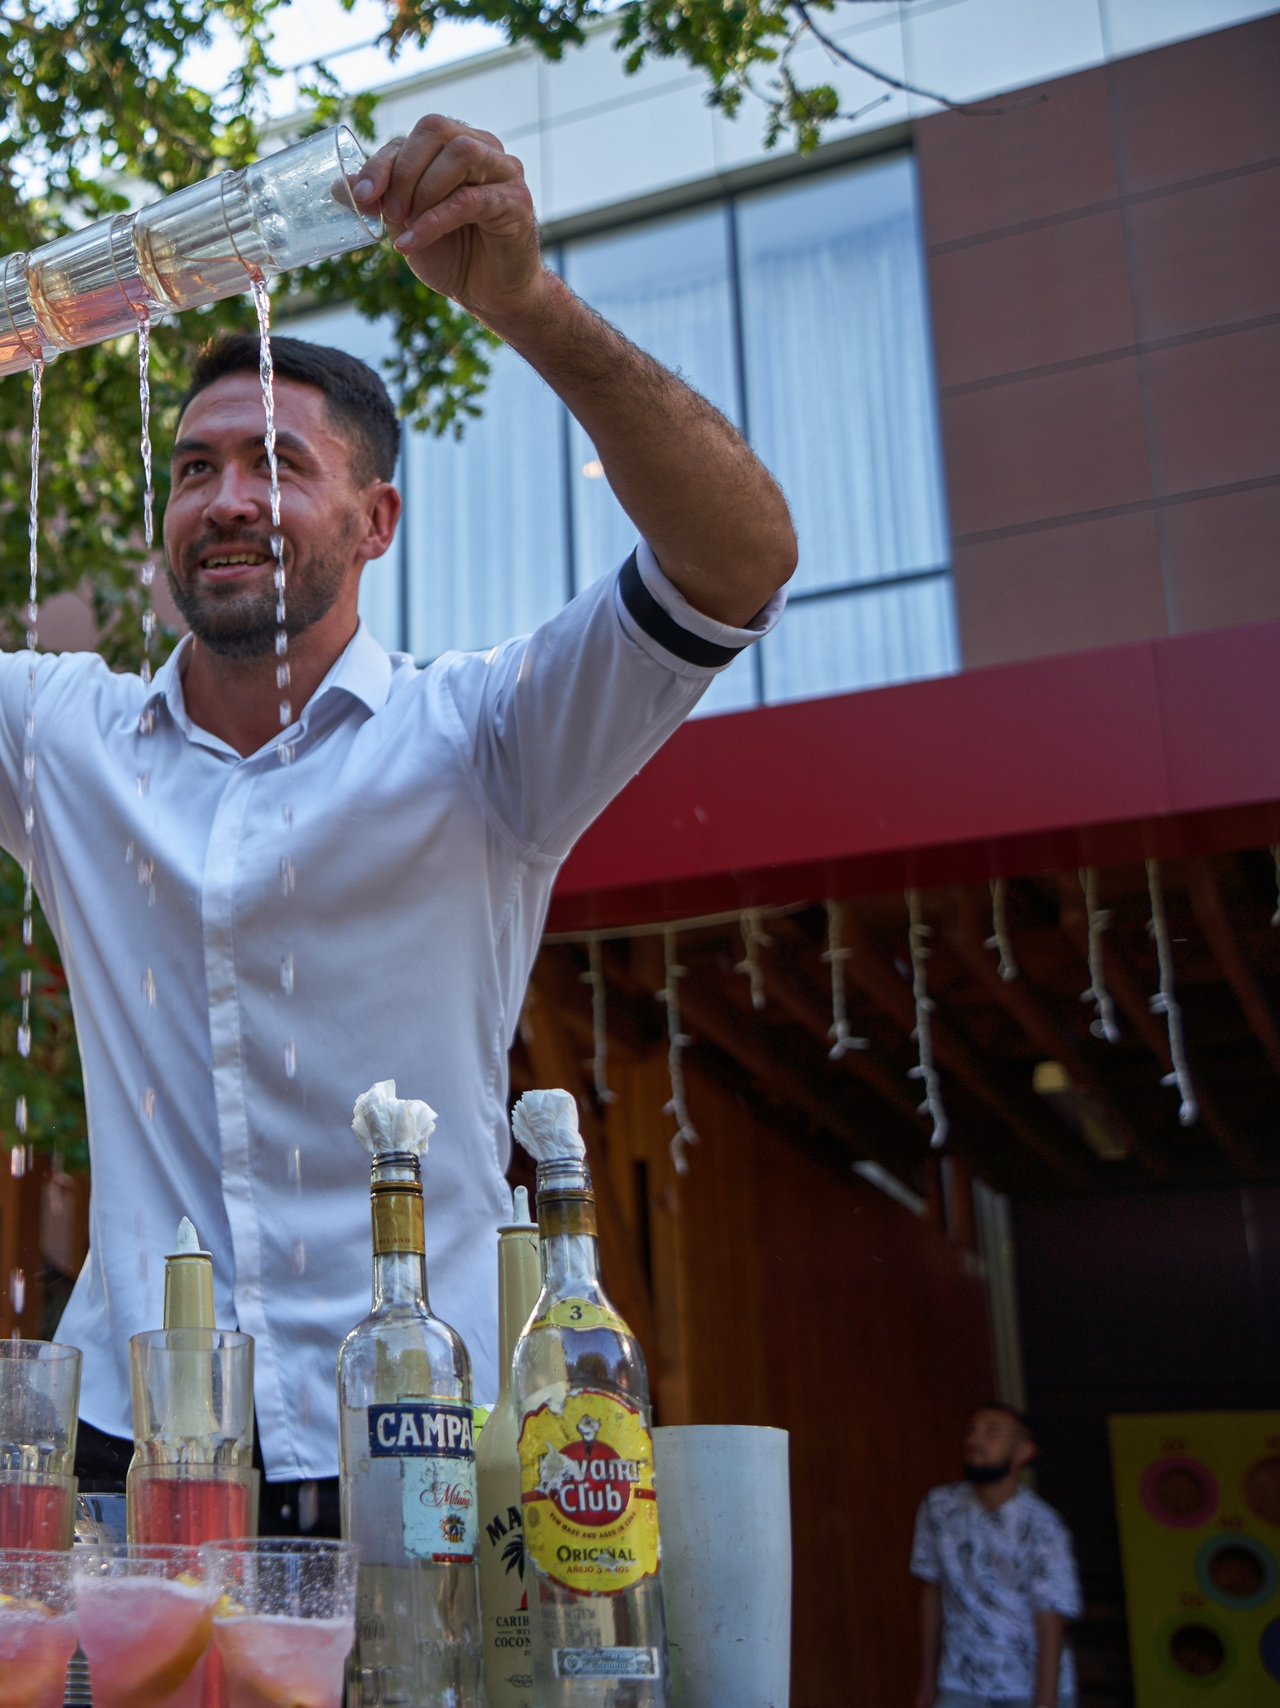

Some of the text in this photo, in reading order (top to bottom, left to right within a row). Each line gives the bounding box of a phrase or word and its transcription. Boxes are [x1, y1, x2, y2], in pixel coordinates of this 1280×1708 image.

[569, 1305, 583, 1320] 3
[376, 1412, 475, 1450] CAMPA
[419, 1481, 473, 1511] Milano
[560, 1483, 622, 1512] Club
[549, 1511, 562, 1527] RUM
[561, 1523, 580, 1537] MADE
[581, 1531, 597, 1539] AND
[599, 1530, 617, 1539] AGED
[617, 1524, 625, 1533] IN
[566, 1563, 594, 1574] AÑEJO
[605, 1566, 630, 1574] AOS
